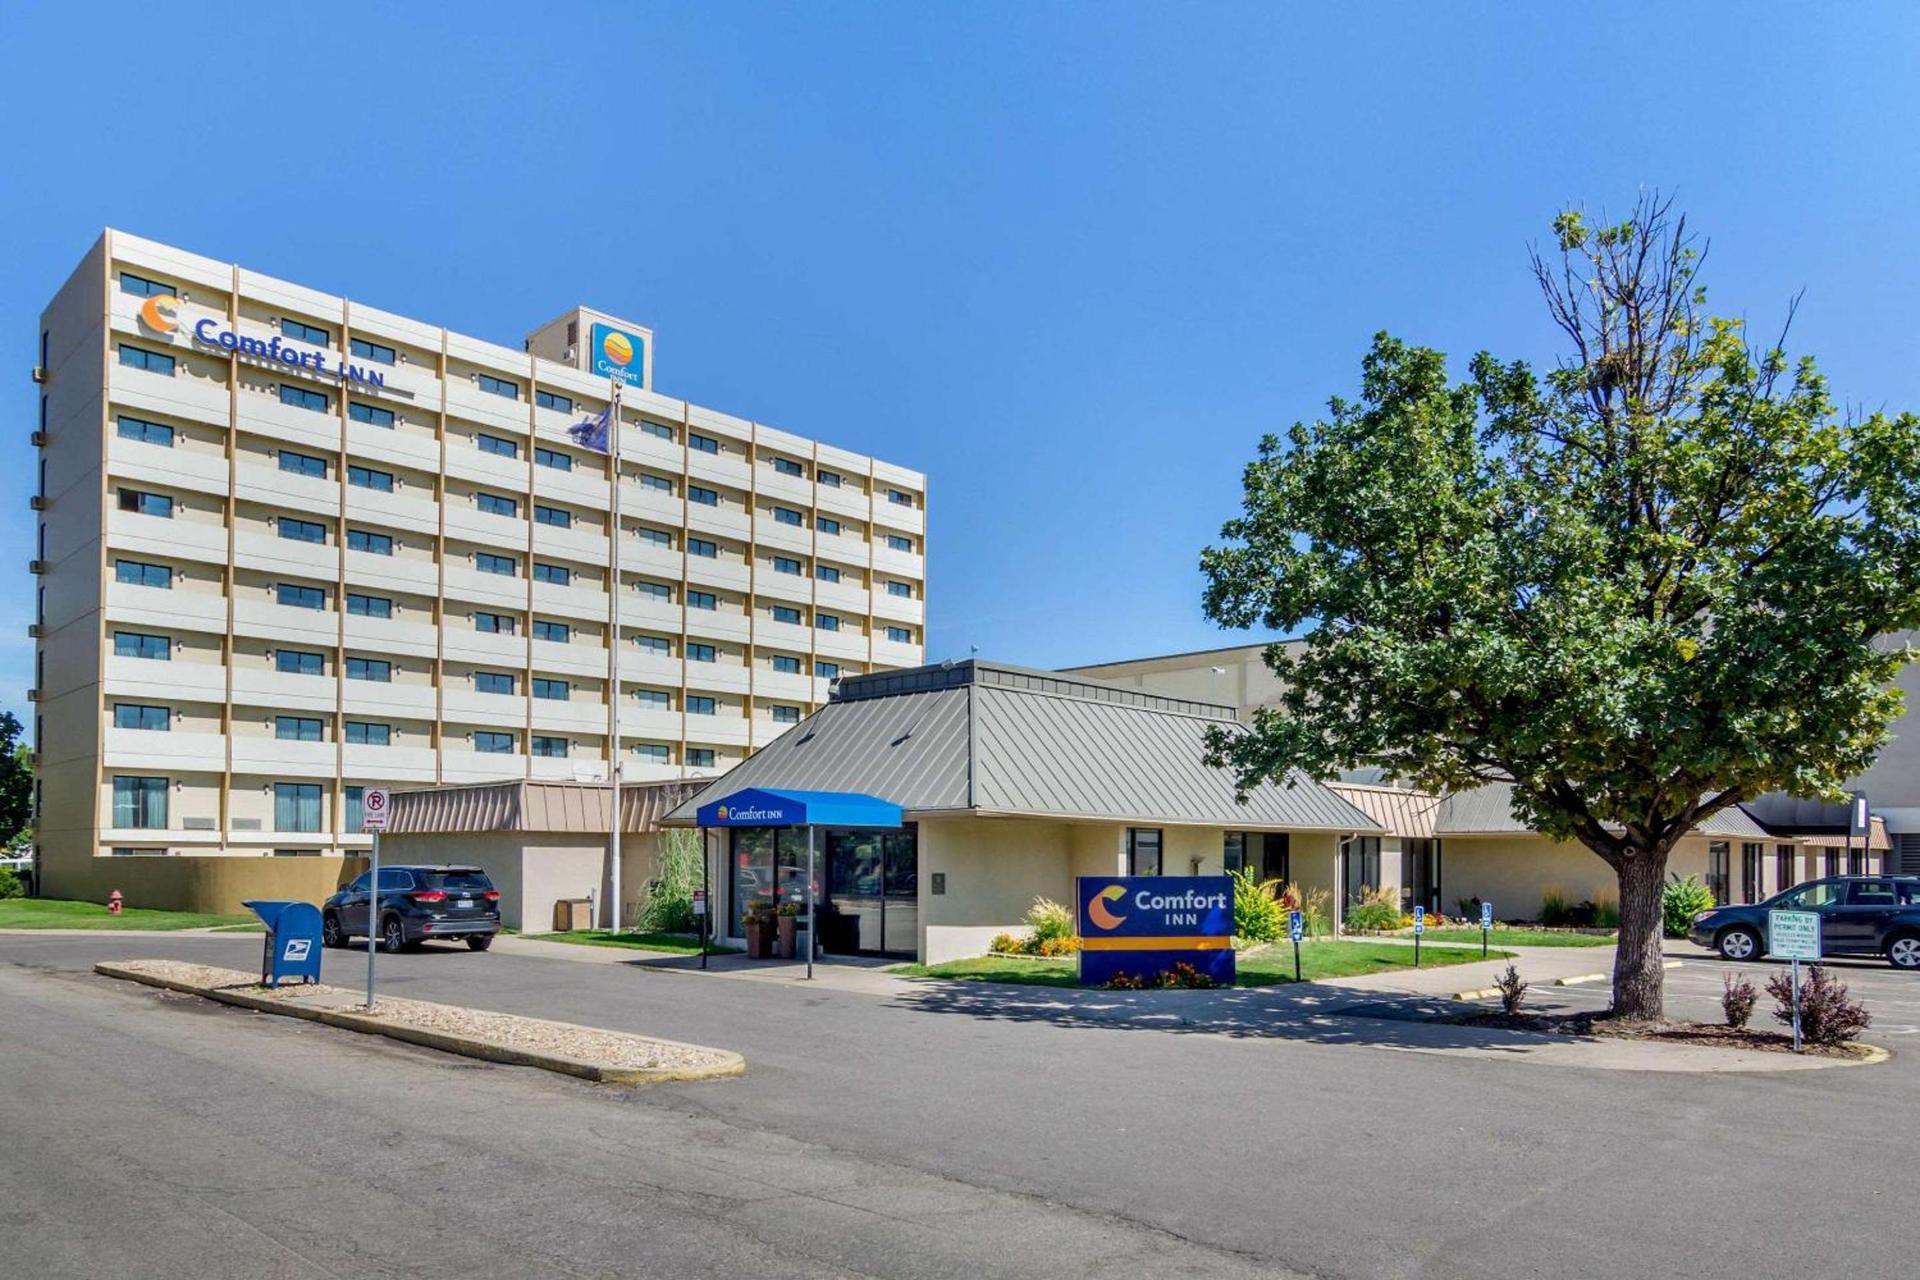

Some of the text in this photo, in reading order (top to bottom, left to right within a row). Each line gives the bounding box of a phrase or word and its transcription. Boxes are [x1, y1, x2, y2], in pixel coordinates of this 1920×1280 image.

[195, 318, 384, 387] Comfort INN
[598, 360, 638, 381] Comfort
[729, 805, 783, 820] Comfort INN
[1135, 889, 1227, 910] Comfort
[1165, 913, 1198, 926] INN
[1775, 914, 1802, 923] PARKING
[1774, 923, 1797, 931] PERMIT
